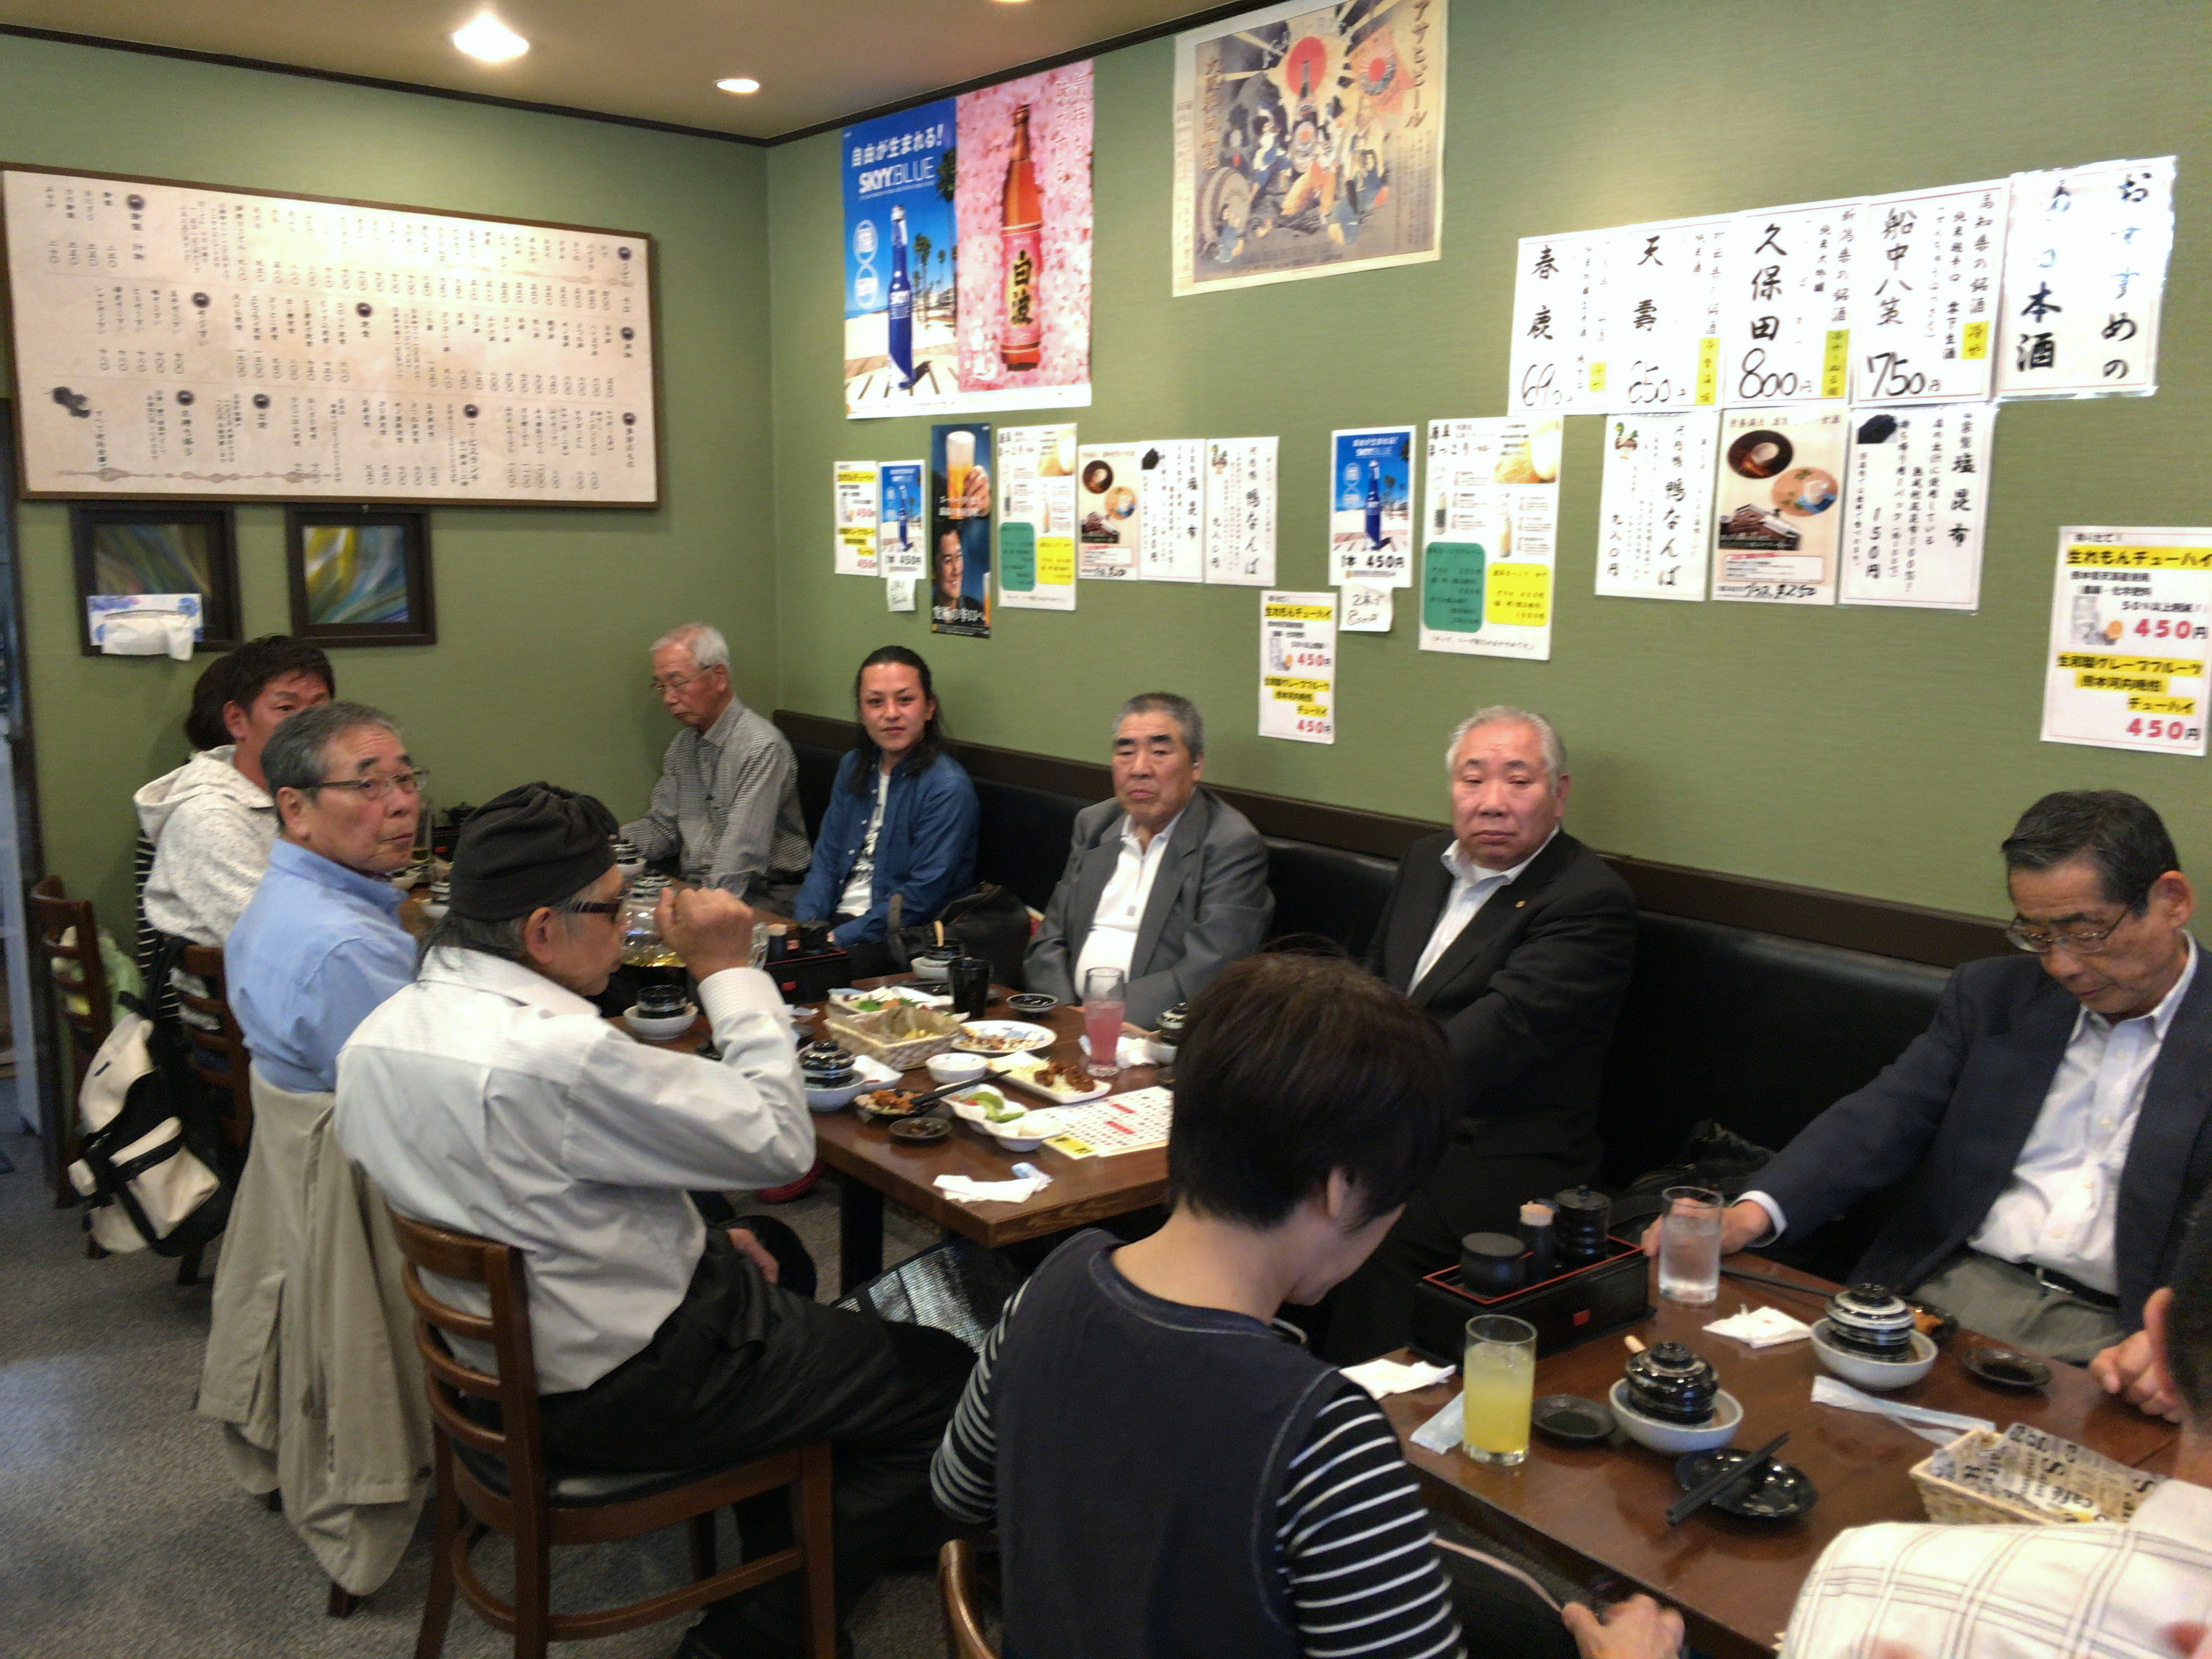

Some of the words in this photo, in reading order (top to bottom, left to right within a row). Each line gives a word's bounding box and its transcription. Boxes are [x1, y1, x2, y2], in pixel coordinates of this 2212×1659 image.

[1527, 245, 1559, 340] 春鹿
[1751, 223, 1788, 341] 久保田
[1866, 352, 1942, 397] 750円
[2132, 618, 2209, 639] 450円
[2125, 718, 2201, 741] 450円
